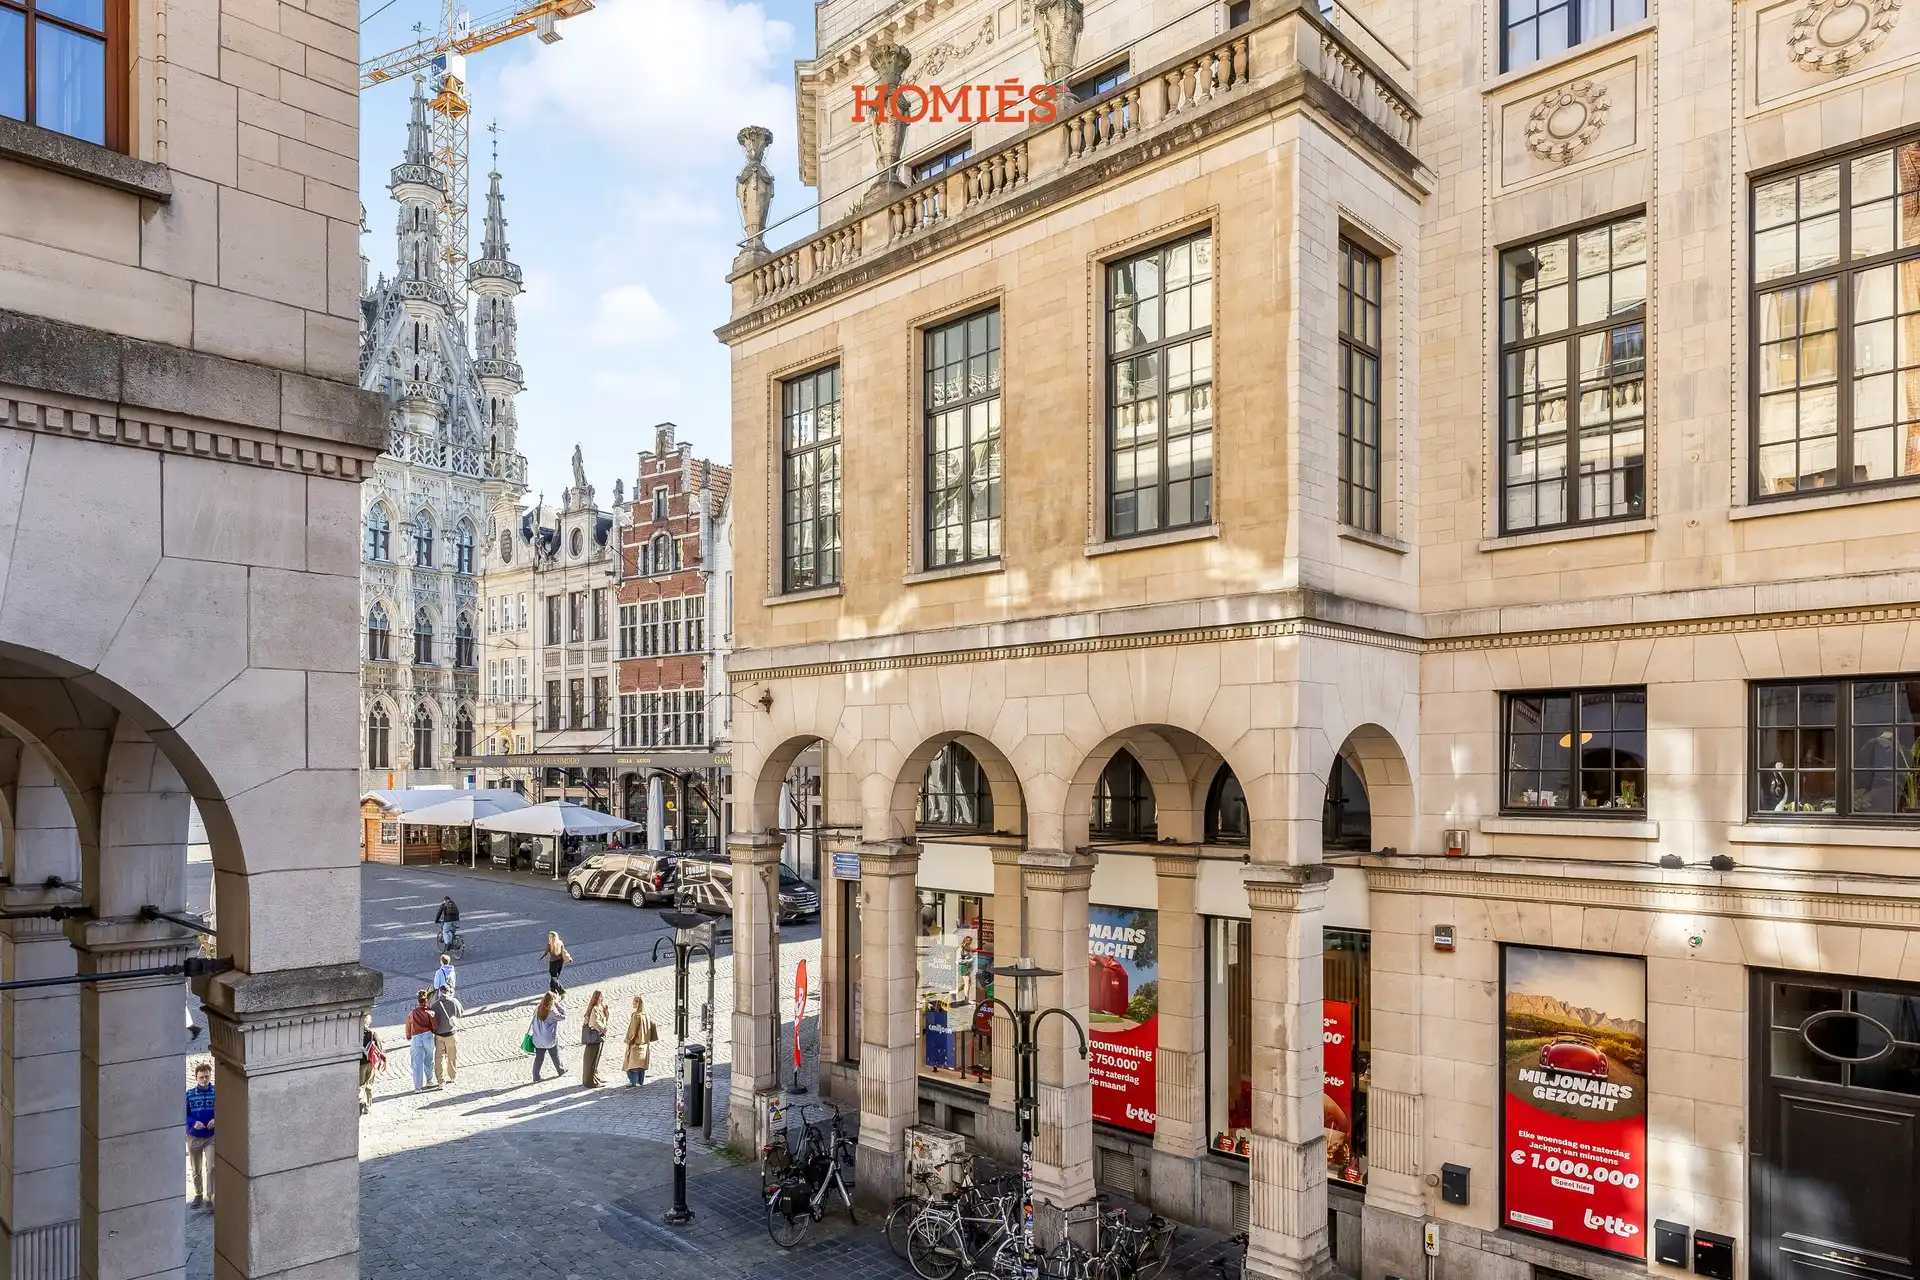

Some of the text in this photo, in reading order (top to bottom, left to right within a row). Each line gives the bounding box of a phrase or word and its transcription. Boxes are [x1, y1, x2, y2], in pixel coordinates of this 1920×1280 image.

[1089, 923, 1147, 944] NAARS
[1100, 1080, 1127, 1093] maand
[1105, 1070, 1140, 1086] zaterdag
[1518, 1068, 1633, 1099] MILJONAIRS
[1532, 1086, 1618, 1112] GEZOCHT
[1518, 1130, 1631, 1160] Elke woensdag en zaterdag
[1529, 1142, 1619, 1166] Jackpot van minstens
[1510, 1149, 1640, 1190] € 1.000.000
[1554, 1178, 1591, 1192] Speel hier
